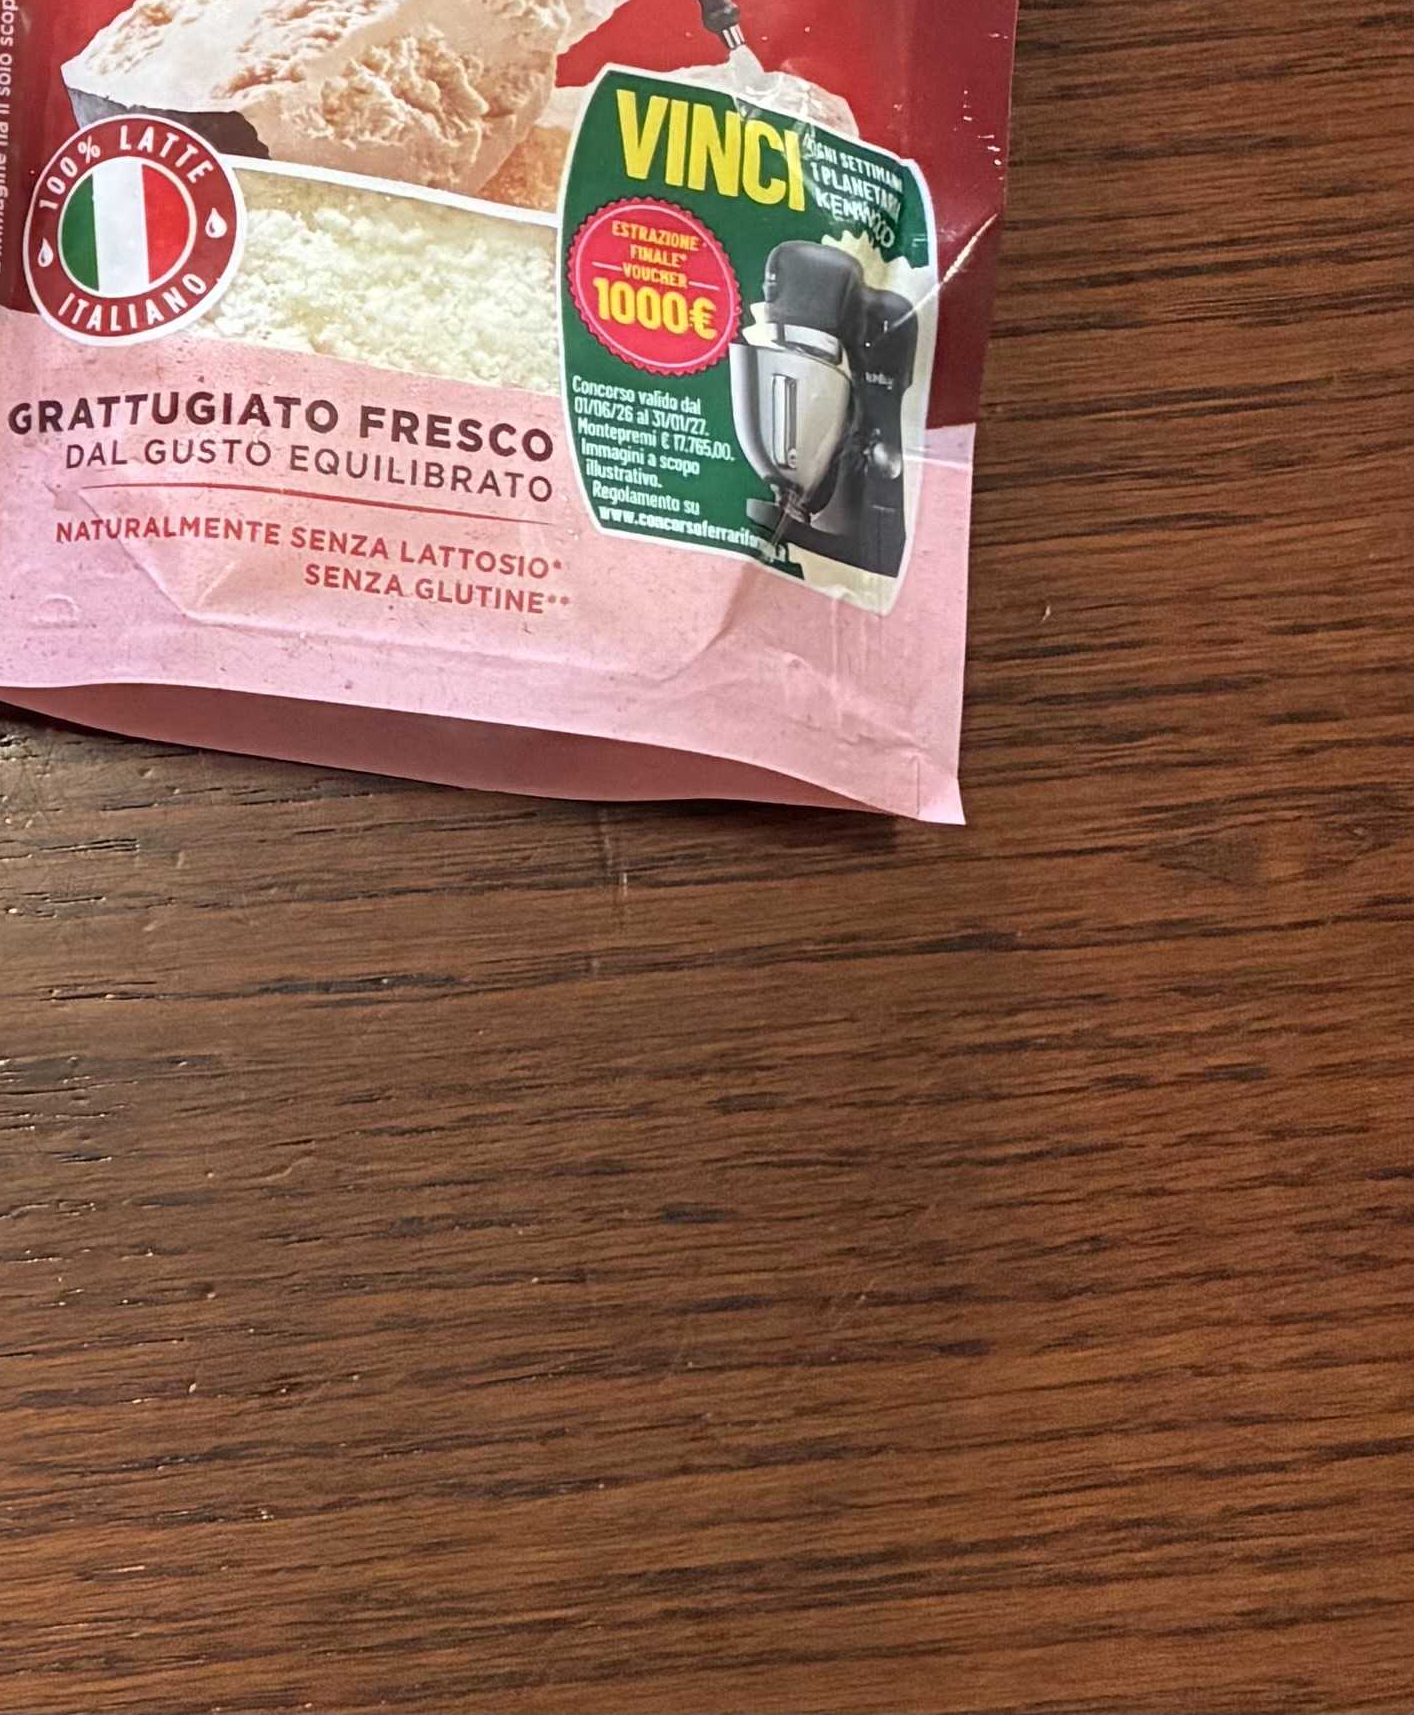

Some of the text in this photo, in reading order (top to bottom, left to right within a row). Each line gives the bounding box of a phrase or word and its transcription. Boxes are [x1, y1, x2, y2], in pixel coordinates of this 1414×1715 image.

[39, 125, 213, 211] 100% LATTE
[616, 89, 805, 212] VINCI
[612, 220, 701, 252] ESTRAZIONE
[623, 263, 688, 289] VOUCHER
[58, 273, 207, 332] ITALIANO
[593, 277, 718, 341] 1000€
[573, 375, 702, 416] Concorso valido dal
[8, 391, 553, 462] GRATTUGIATO FRESCO
[578, 417, 658, 447] Montepremi
[660, 432, 670, 450] €
[636, 409, 650, 427] al
[66, 438, 553, 502] DAL GUSTO EQUILIBRATO
[581, 438, 700, 478] Immagini a scopo
[585, 460, 663, 488] illustrativo.
[592, 480, 700, 516] Regolamento su
[56, 516, 281, 546] NATURALMENTE
[290, 526, 390, 560] SENZA
[304, 563, 405, 597] SENZA
